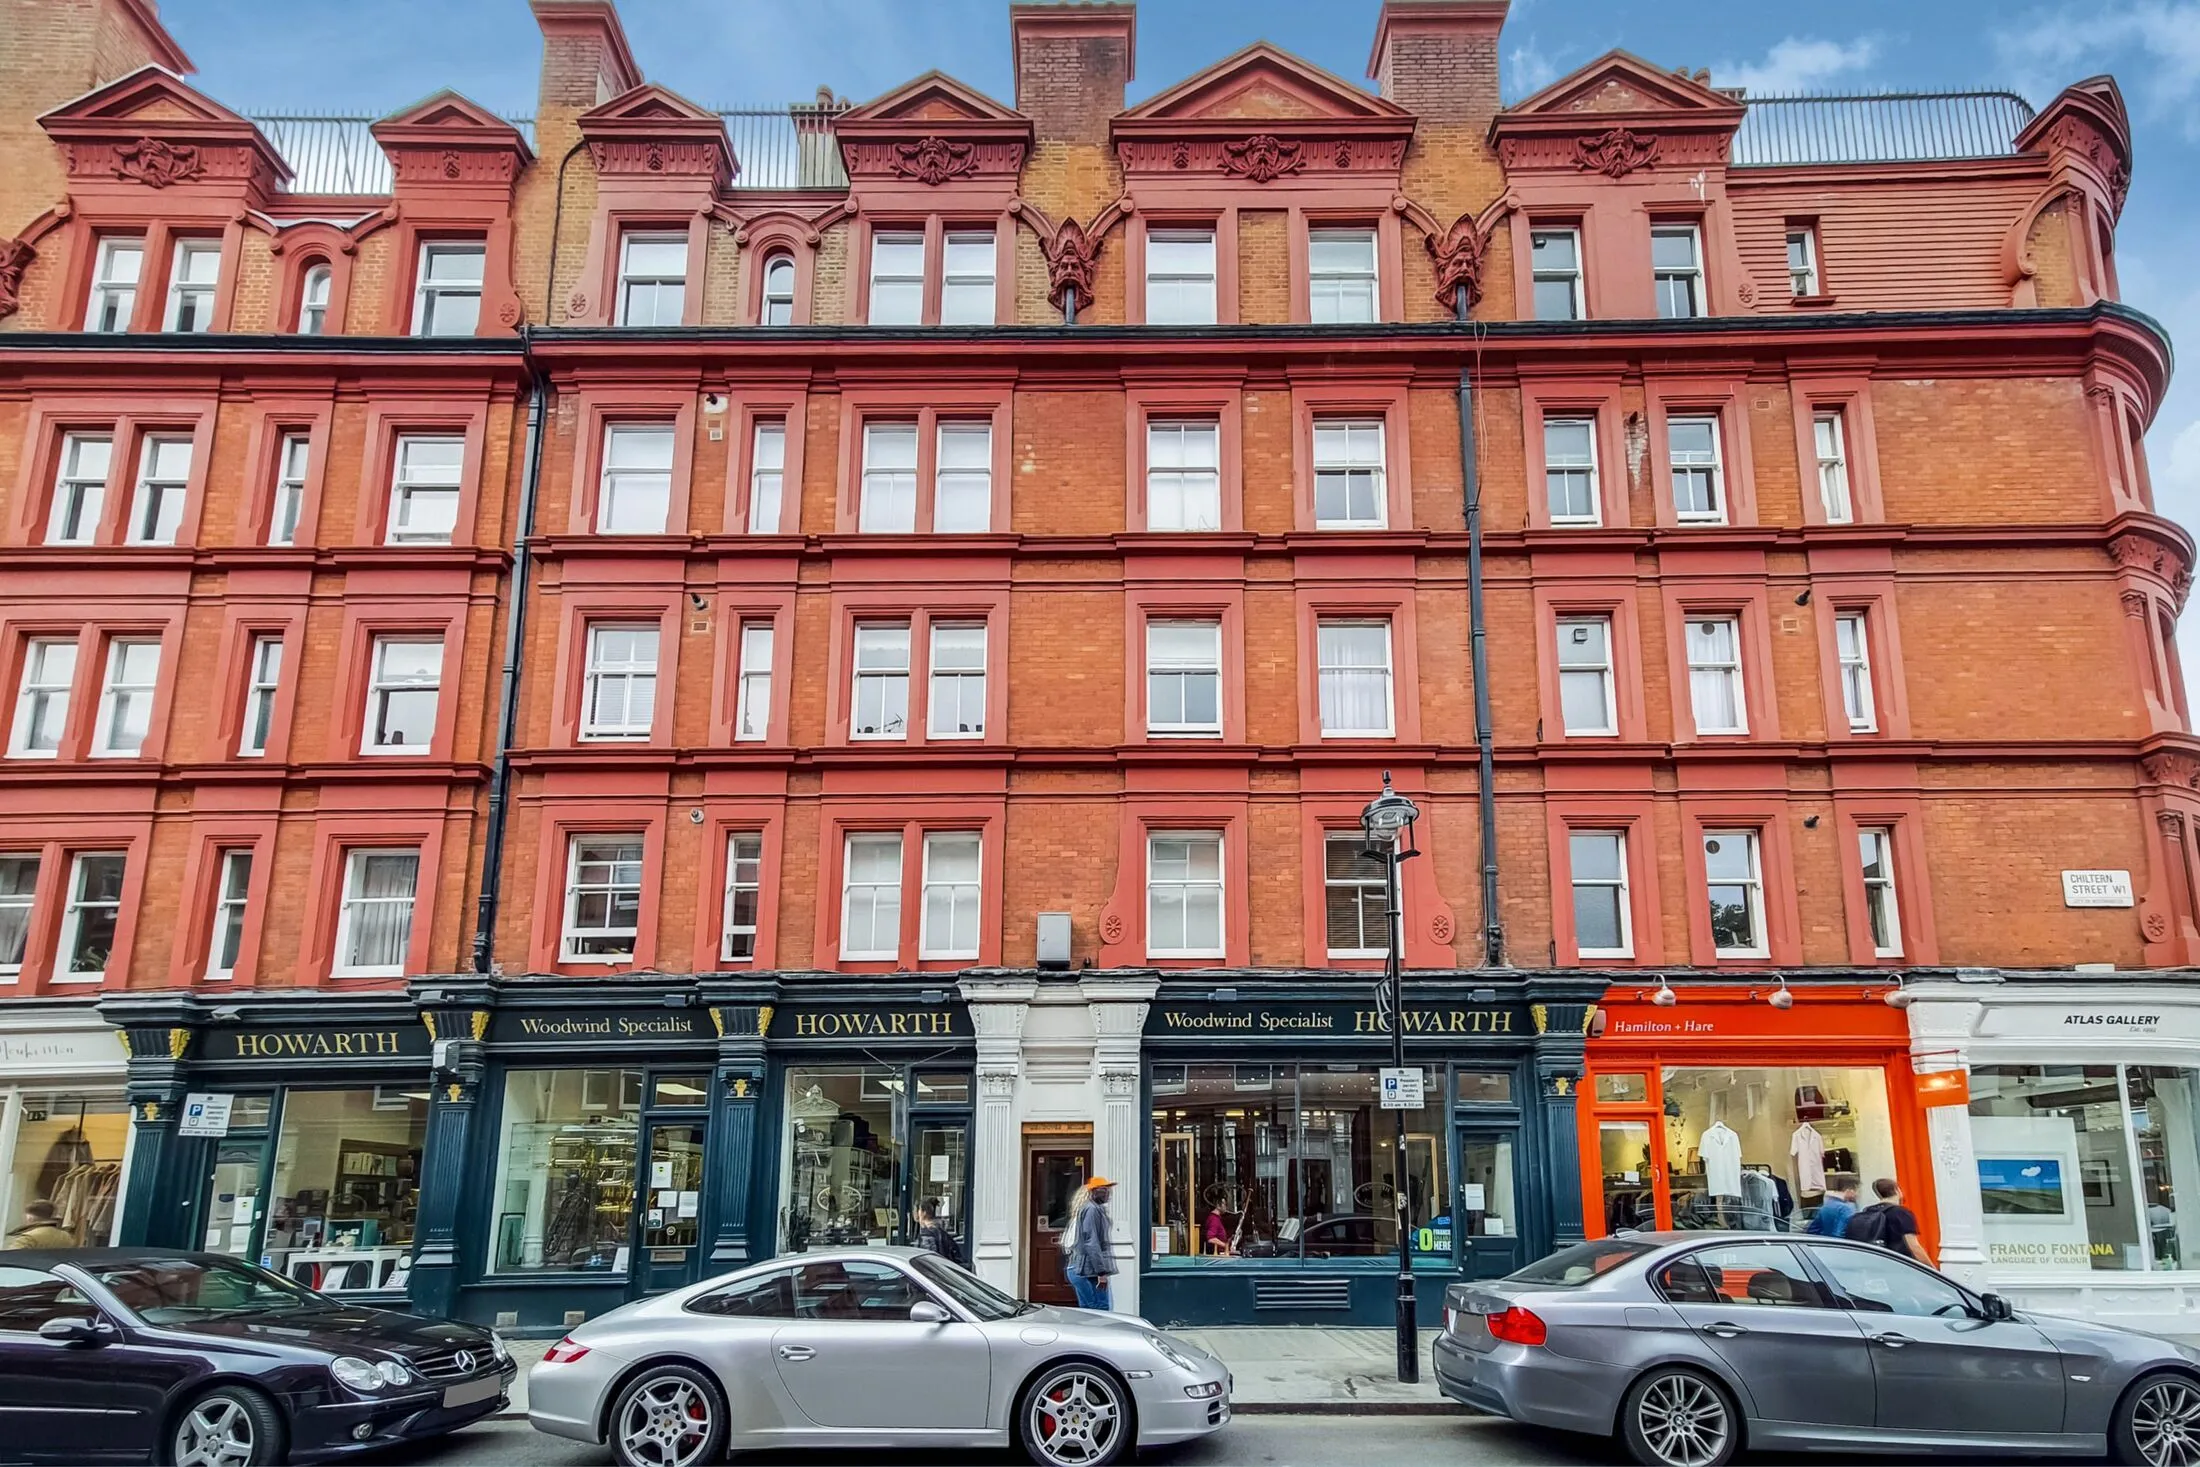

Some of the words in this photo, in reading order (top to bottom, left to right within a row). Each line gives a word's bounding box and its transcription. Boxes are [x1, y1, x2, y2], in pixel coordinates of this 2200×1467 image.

[2070, 874, 2113, 883] CHILTERN
[2072, 885, 2107, 894] STREET
[2113, 885, 2126, 895] W1
[796, 1013, 952, 1035] HOWARTH
[1164, 1012, 1252, 1028] Woodwind
[1259, 1012, 1333, 1030] Specialist
[1354, 1011, 1512, 1032] HOWARTH
[1615, 1021, 1671, 1032] Hamilton
[1684, 1020, 1714, 1031] Hare
[2064, 1015, 2103, 1025] ATLAS
[2106, 1015, 2160, 1025] GALLERY
[520, 1018, 611, 1034] Woodwind
[618, 1017, 693, 1036] Specialist
[236, 1032, 399, 1055] HOWARTH
[1388, 1079, 1396, 1089] P
[192, 1105, 201, 1115] P
[1419, 1228, 1433, 1251] 0
[1433, 1241, 1451, 1251] HERE
[1990, 1243, 2046, 1255] FRANCO
[2051, 1243, 2115, 1256] FONTANA
[1991, 1256, 2037, 1264] LANGUAGE
[2040, 1256, 2050, 1264] OF
[2053, 1256, 2088, 1264] COLOUR
